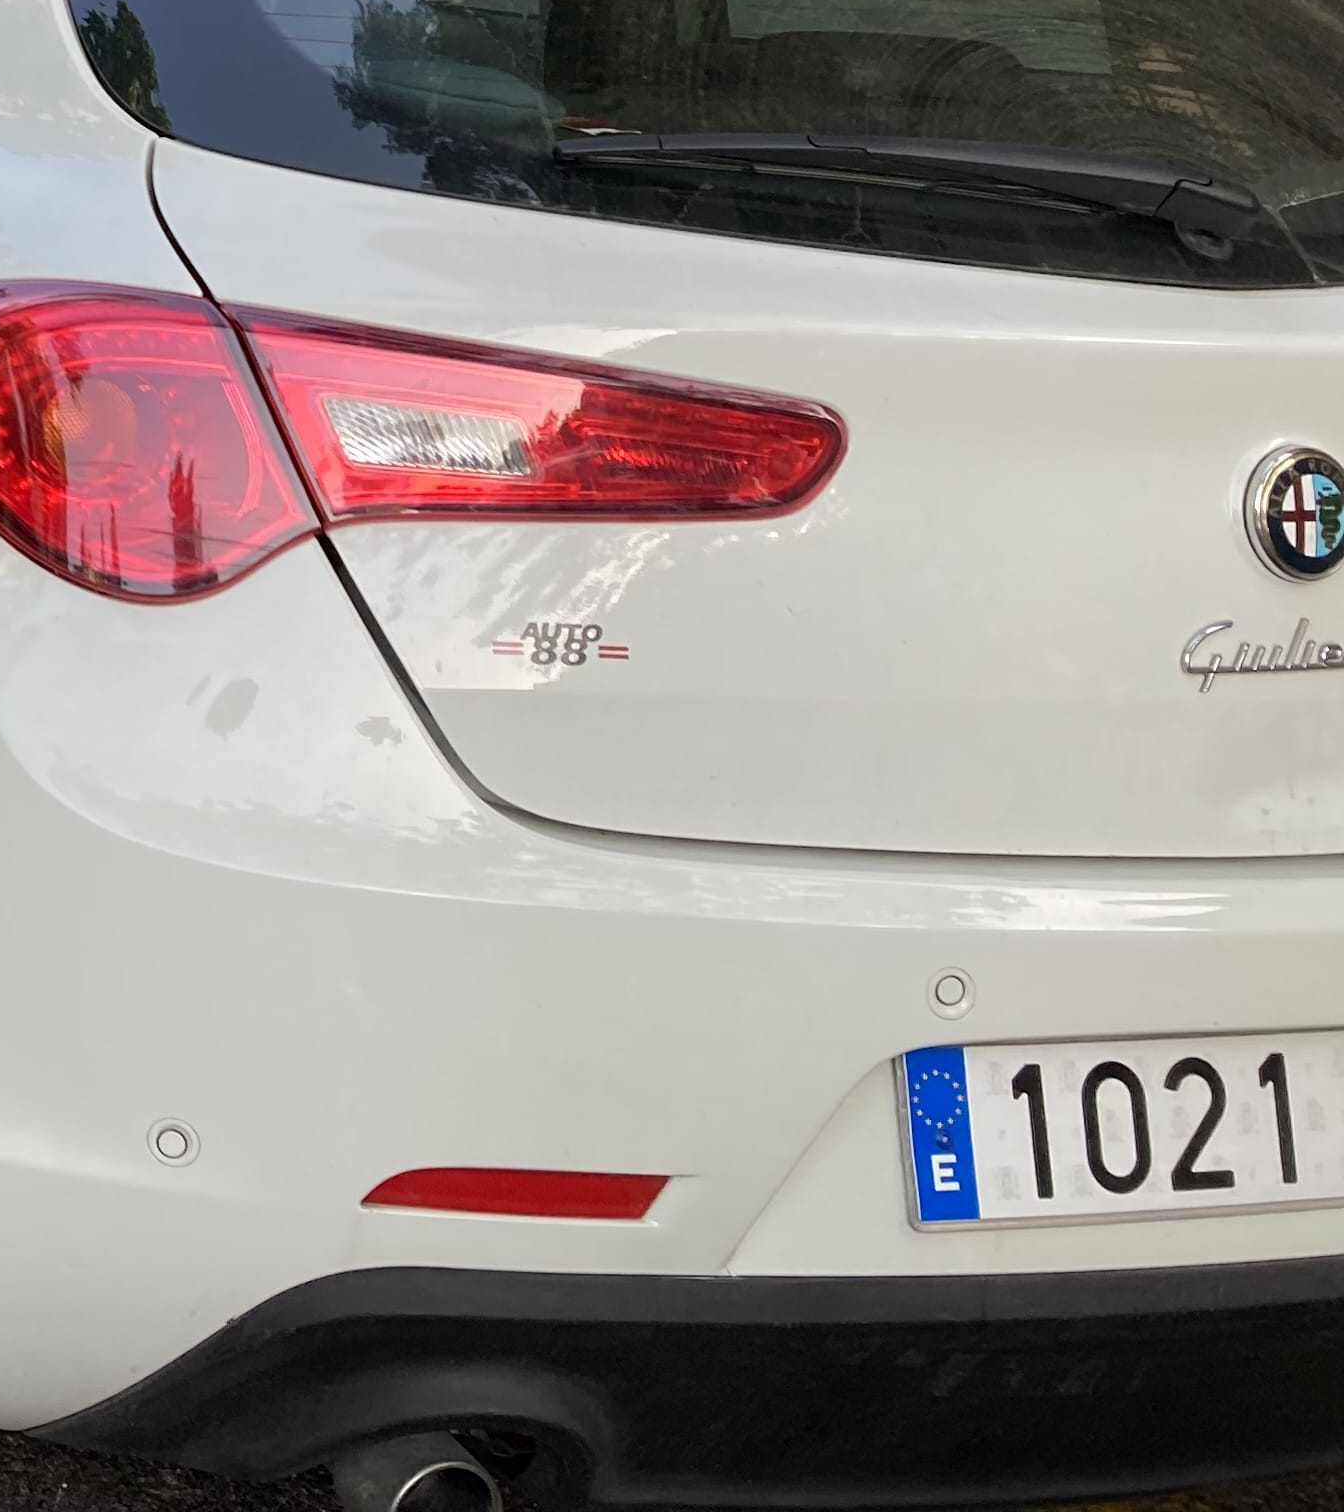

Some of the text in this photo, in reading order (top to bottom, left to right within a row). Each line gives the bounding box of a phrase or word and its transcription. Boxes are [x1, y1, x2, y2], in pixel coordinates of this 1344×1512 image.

[520, 622, 603, 643] AUTO
[530, 639, 588, 666] 88
[1012, 1052, 1298, 1200] 1021
[930, 1153, 961, 1192] E
